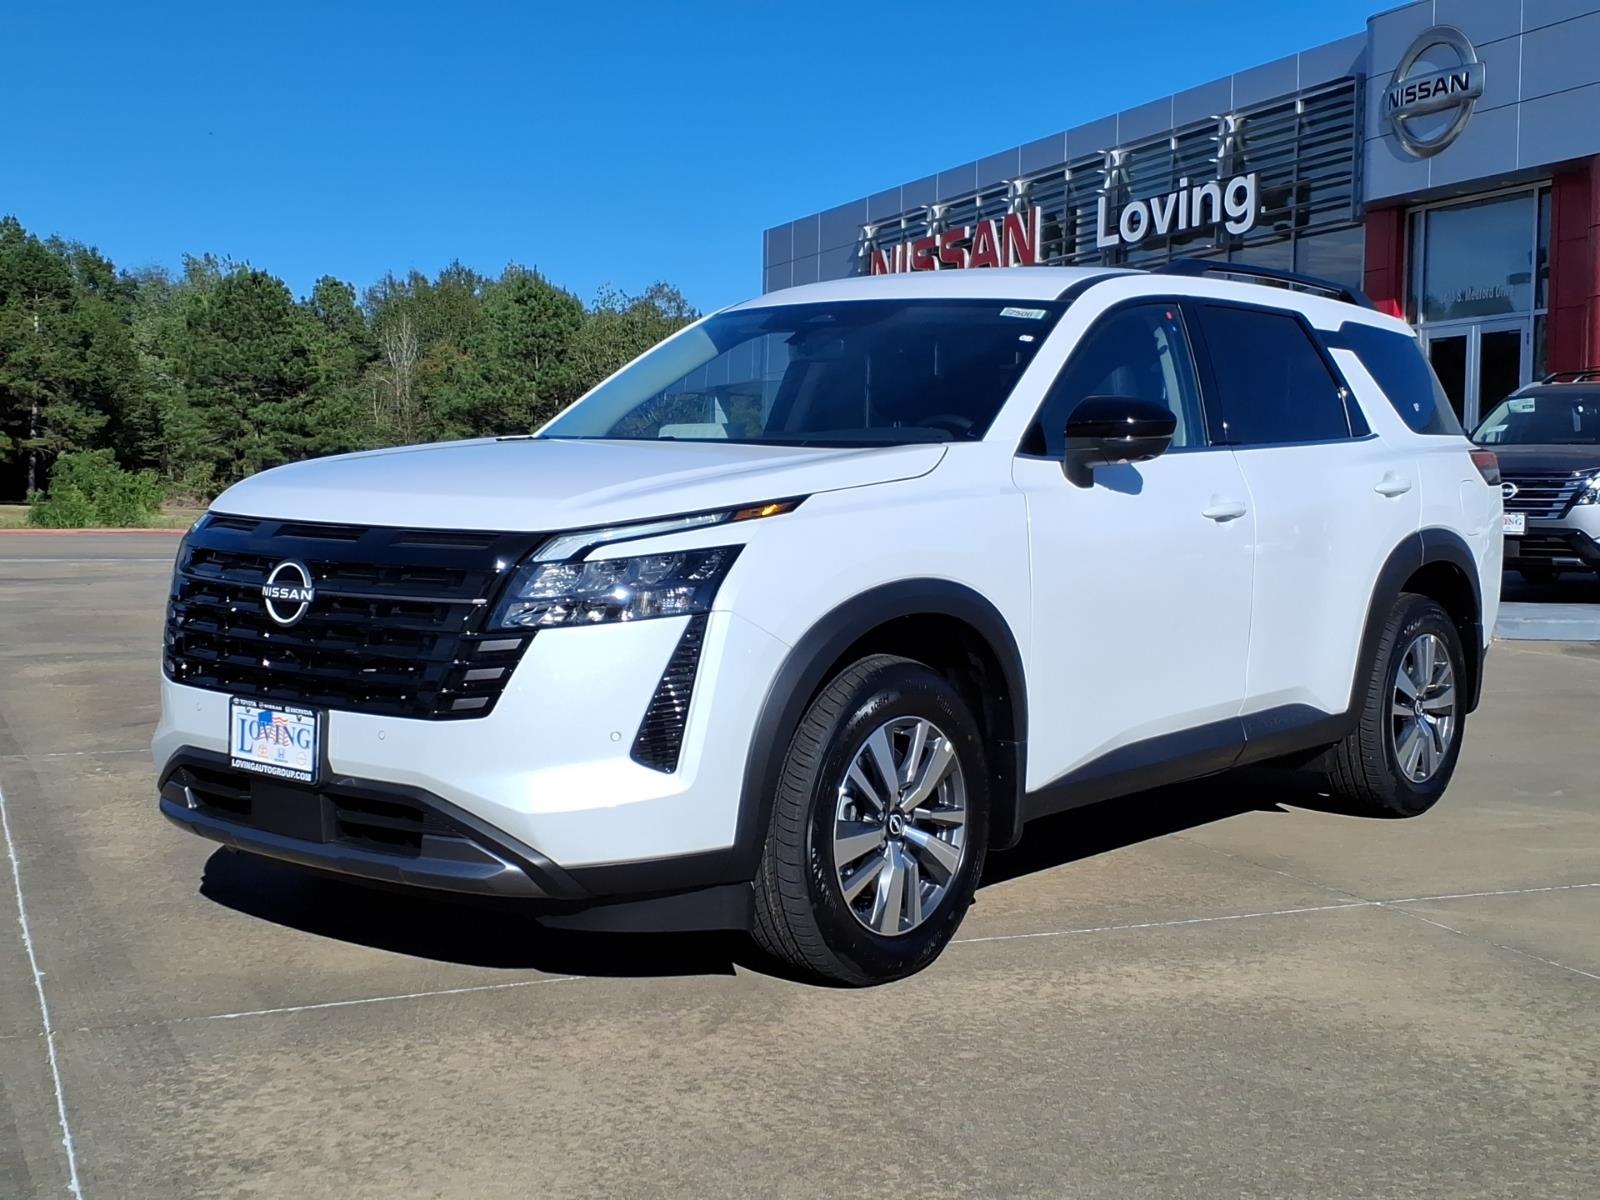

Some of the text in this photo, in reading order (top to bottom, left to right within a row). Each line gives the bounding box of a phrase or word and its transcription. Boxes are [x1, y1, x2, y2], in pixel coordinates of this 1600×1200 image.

[1388, 72, 1470, 110] NISSAN
[1097, 173, 1256, 248] Loving
[870, 206, 1041, 276] NISSAN
[262, 586, 313, 601] NISSAN
[238, 718, 311, 753] LOVING
[231, 758, 312, 781] LOVINGAUTOGROUP.COM
